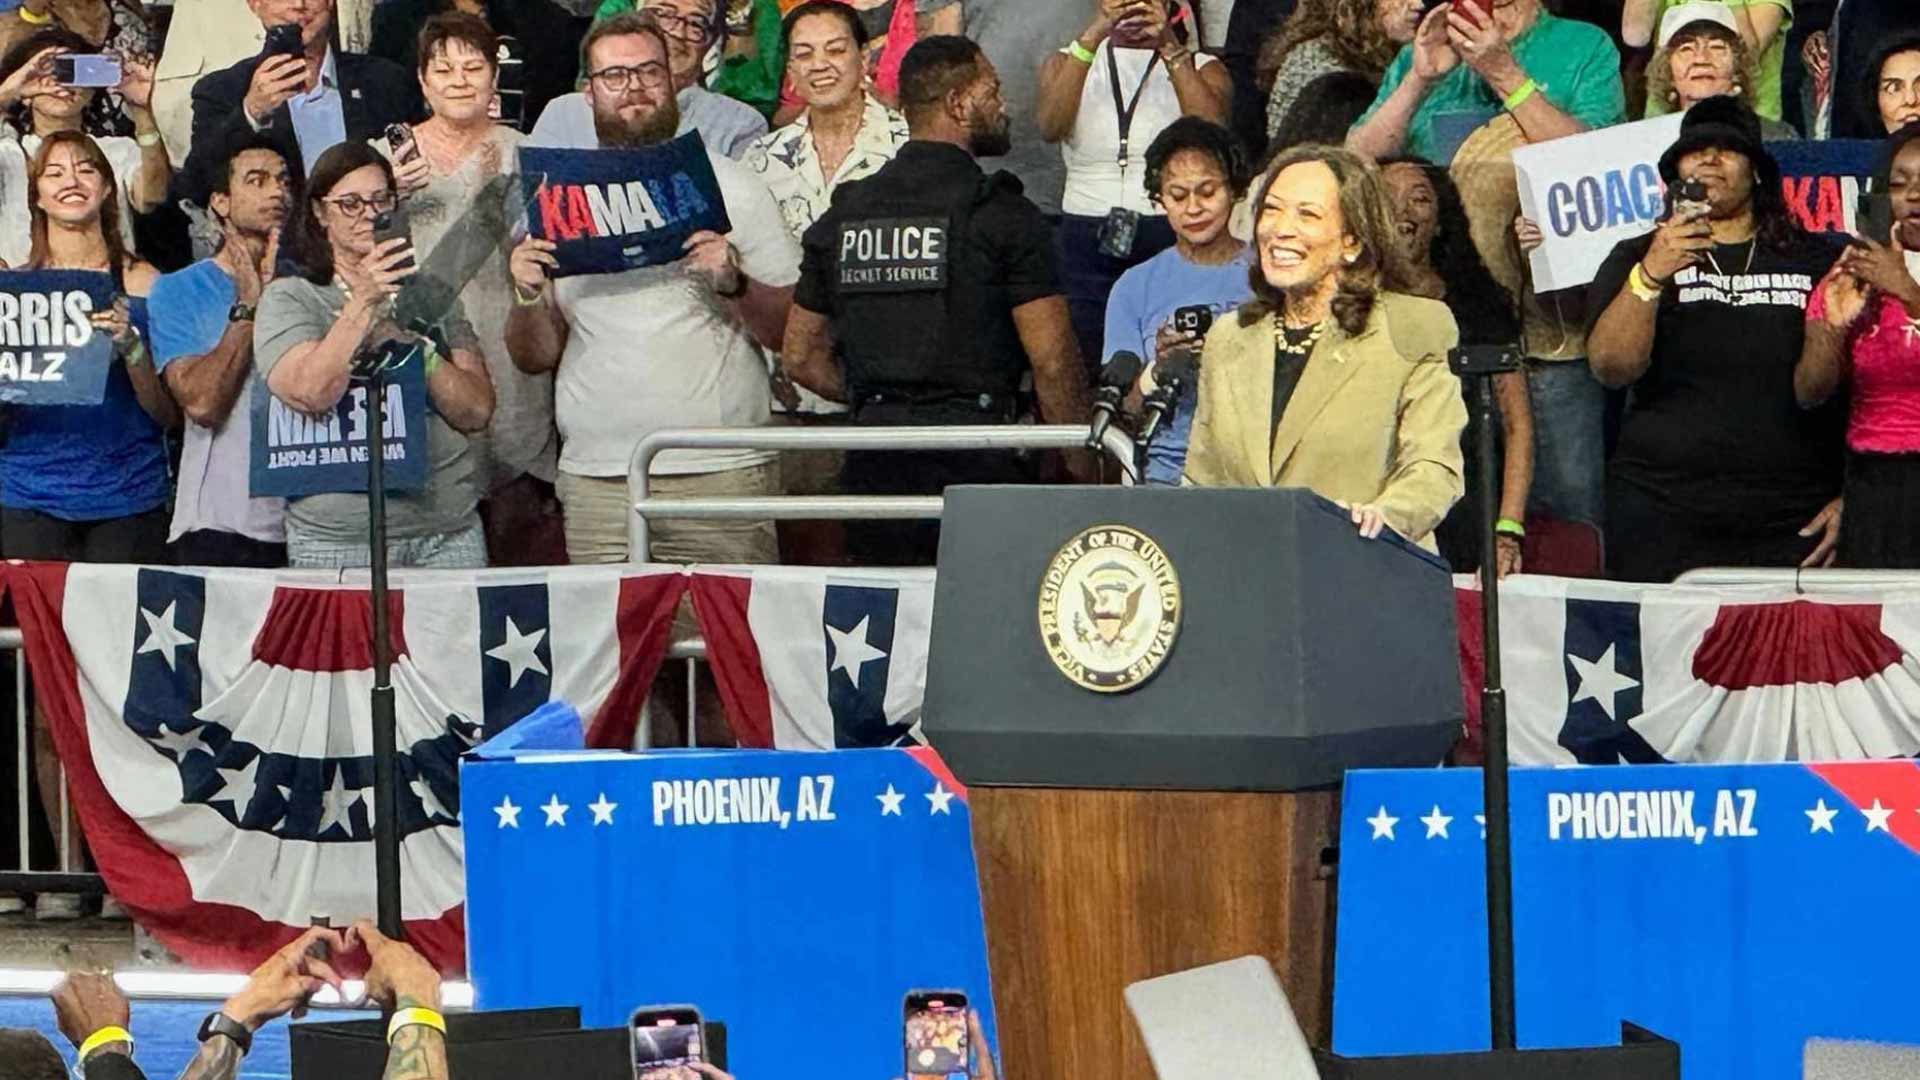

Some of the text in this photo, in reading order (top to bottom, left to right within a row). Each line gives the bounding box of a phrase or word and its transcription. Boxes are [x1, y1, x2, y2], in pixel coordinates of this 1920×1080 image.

[537, 171, 709, 241] KAMALA
[1547, 163, 1664, 237] COAC
[840, 226, 942, 261] POLICE
[268, 450, 317, 469] FIGHT
[319, 447, 349, 465] WE
[652, 775, 836, 829] PHOENIX, AZ
[1548, 789, 1758, 845] PHOENIX, AZ
